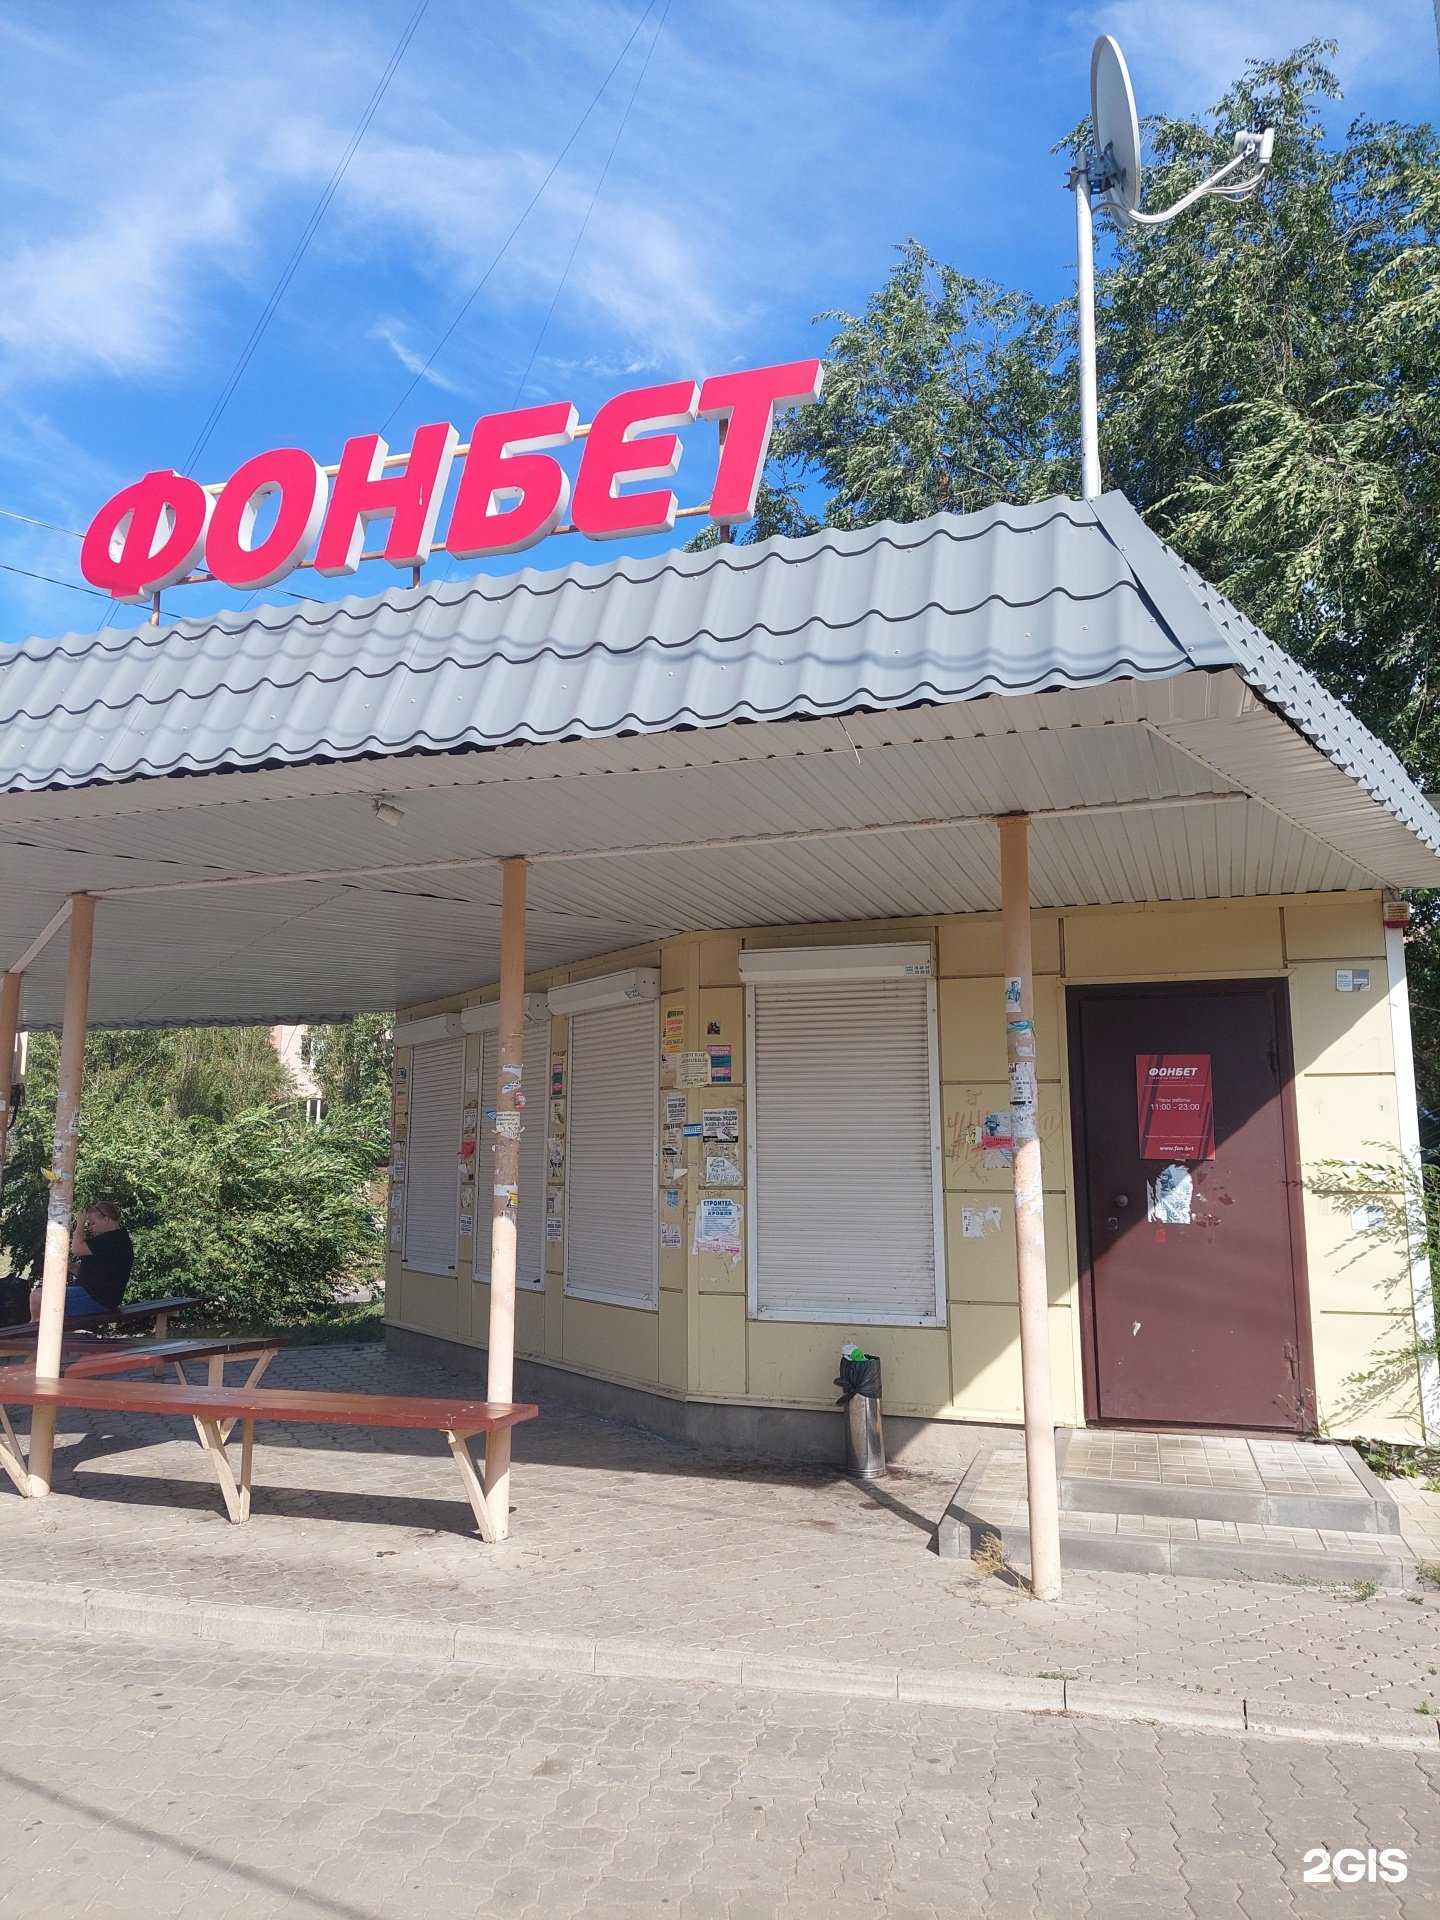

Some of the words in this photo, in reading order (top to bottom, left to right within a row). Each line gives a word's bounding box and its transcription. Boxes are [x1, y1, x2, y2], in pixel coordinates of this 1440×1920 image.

[80, 358, 823, 603] ФОНБЕТ
[1148, 1067, 1199, 1076] ФОНБЕТ
[1151, 1103, 1171, 1111] 11:00
[1178, 1103, 1200, 1111] 23:00
